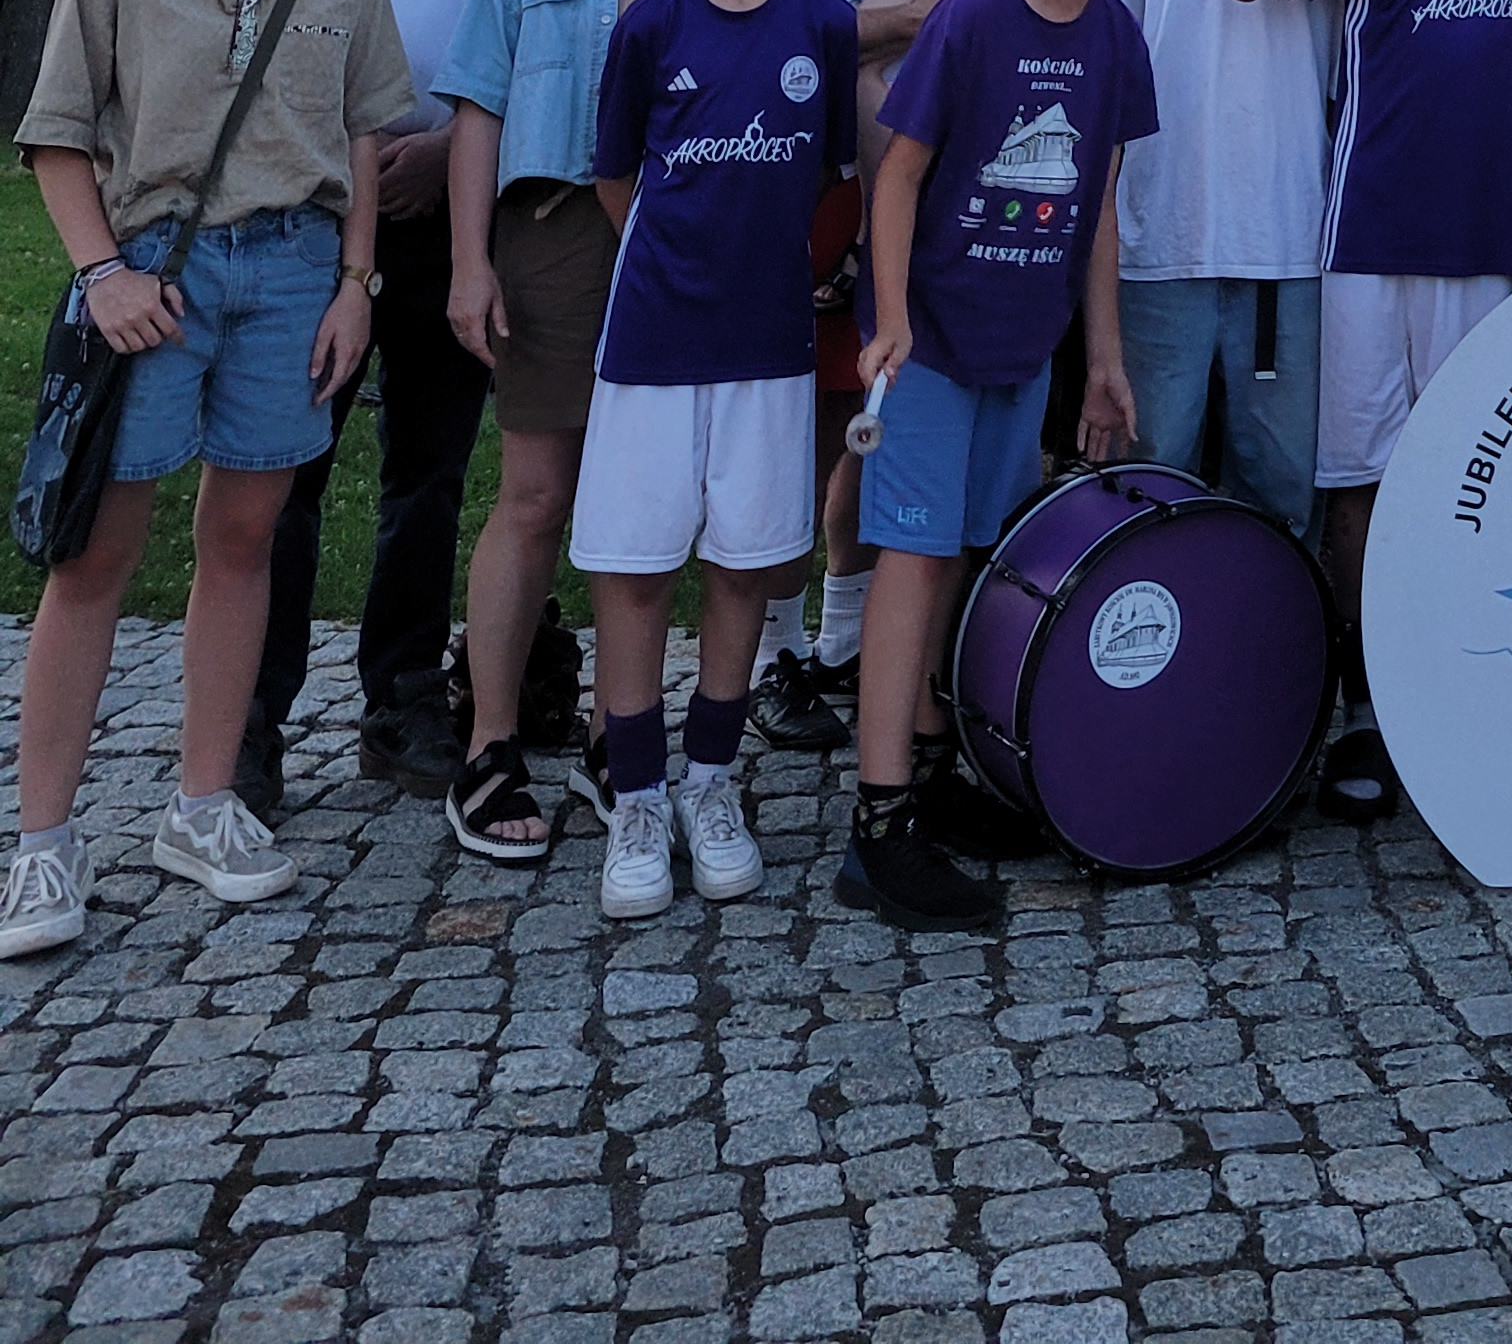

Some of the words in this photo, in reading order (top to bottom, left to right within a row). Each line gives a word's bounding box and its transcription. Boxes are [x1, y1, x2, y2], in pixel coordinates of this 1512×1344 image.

[1017, 57, 1085, 76] KOŚCIÓŁ
[671, 136, 796, 165] AKROPROCES
[967, 243, 1029, 267] MUSZĘ
